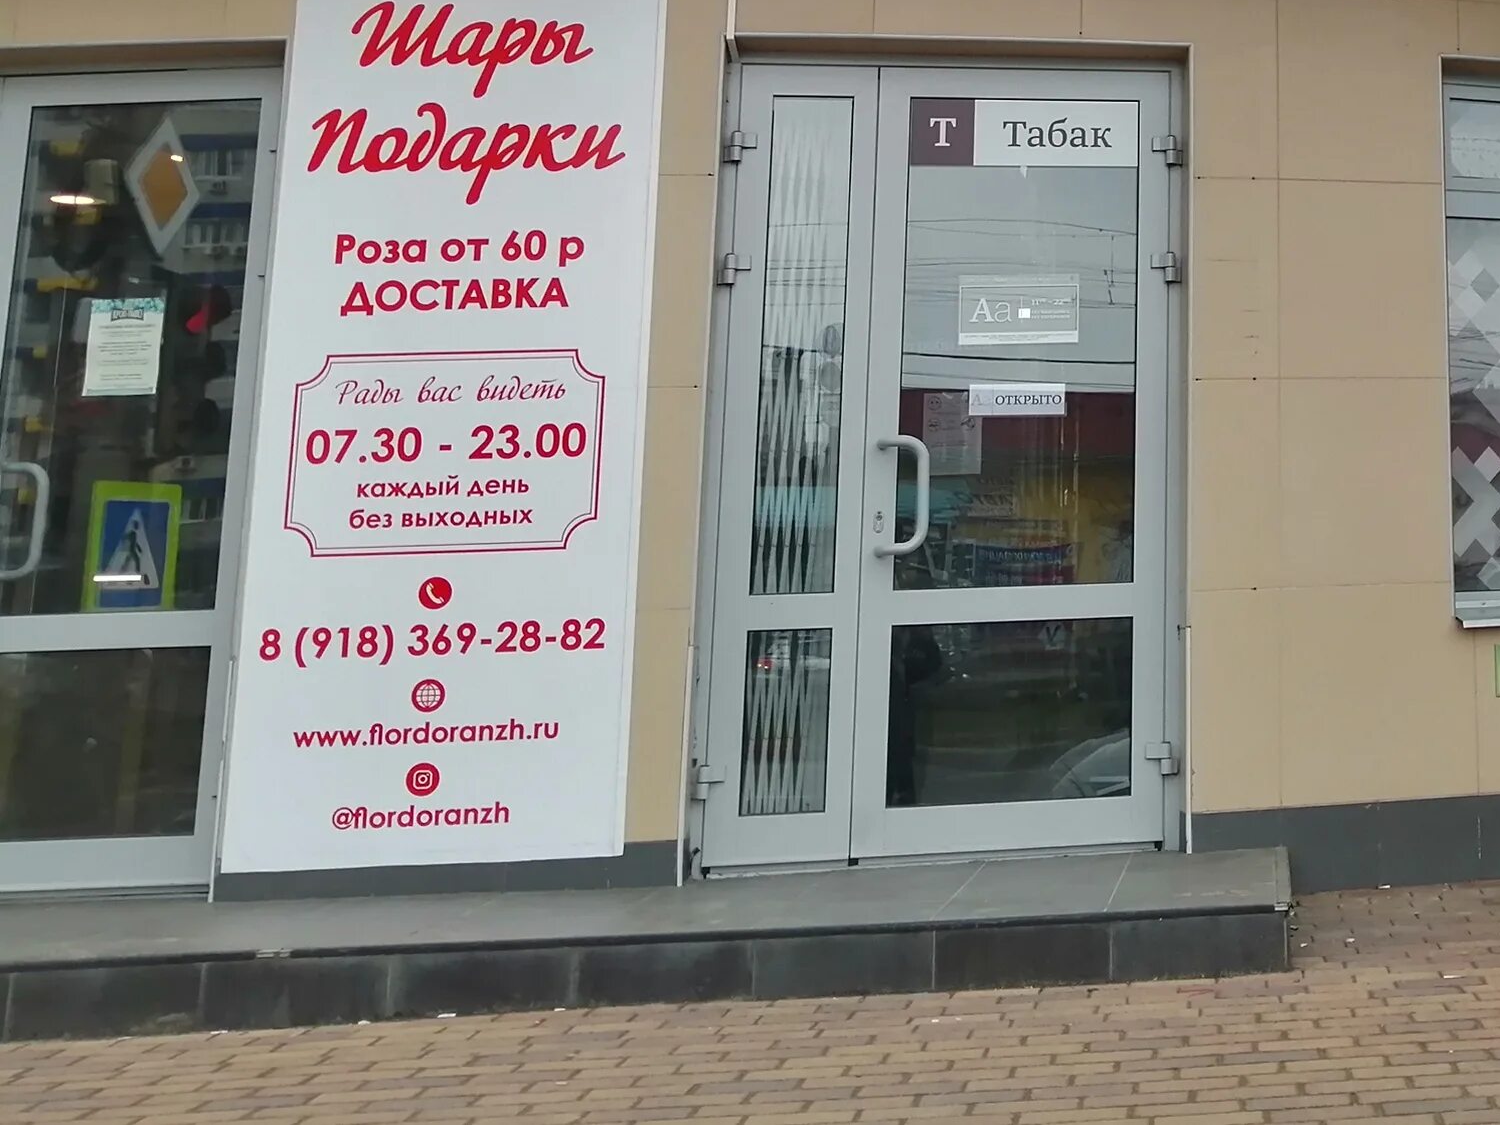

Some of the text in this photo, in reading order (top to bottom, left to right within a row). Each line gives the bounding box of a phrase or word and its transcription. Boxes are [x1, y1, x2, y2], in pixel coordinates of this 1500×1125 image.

[351, 1, 594, 99] Шары
[929, 117, 957, 147] Т
[1003, 117, 1113, 149] Табак
[307, 102, 626, 206] Подарки
[334, 230, 585, 266] Роза от 60 р
[340, 277, 570, 317] ДОСТАВКА
[335, 374, 567, 406] Рады вас видеть
[995, 394, 1062, 406] ОТКРЫТО
[305, 426, 423, 465] 07.30
[469, 421, 587, 460] 23.00
[356, 474, 530, 500] каждый день
[349, 507, 534, 530] без выходных
[258, 618, 606, 668] 8 (918) 369-28-82
[293, 718, 560, 749] www.flordoranzh.ru
[331, 801, 511, 831] @flordoranzh
